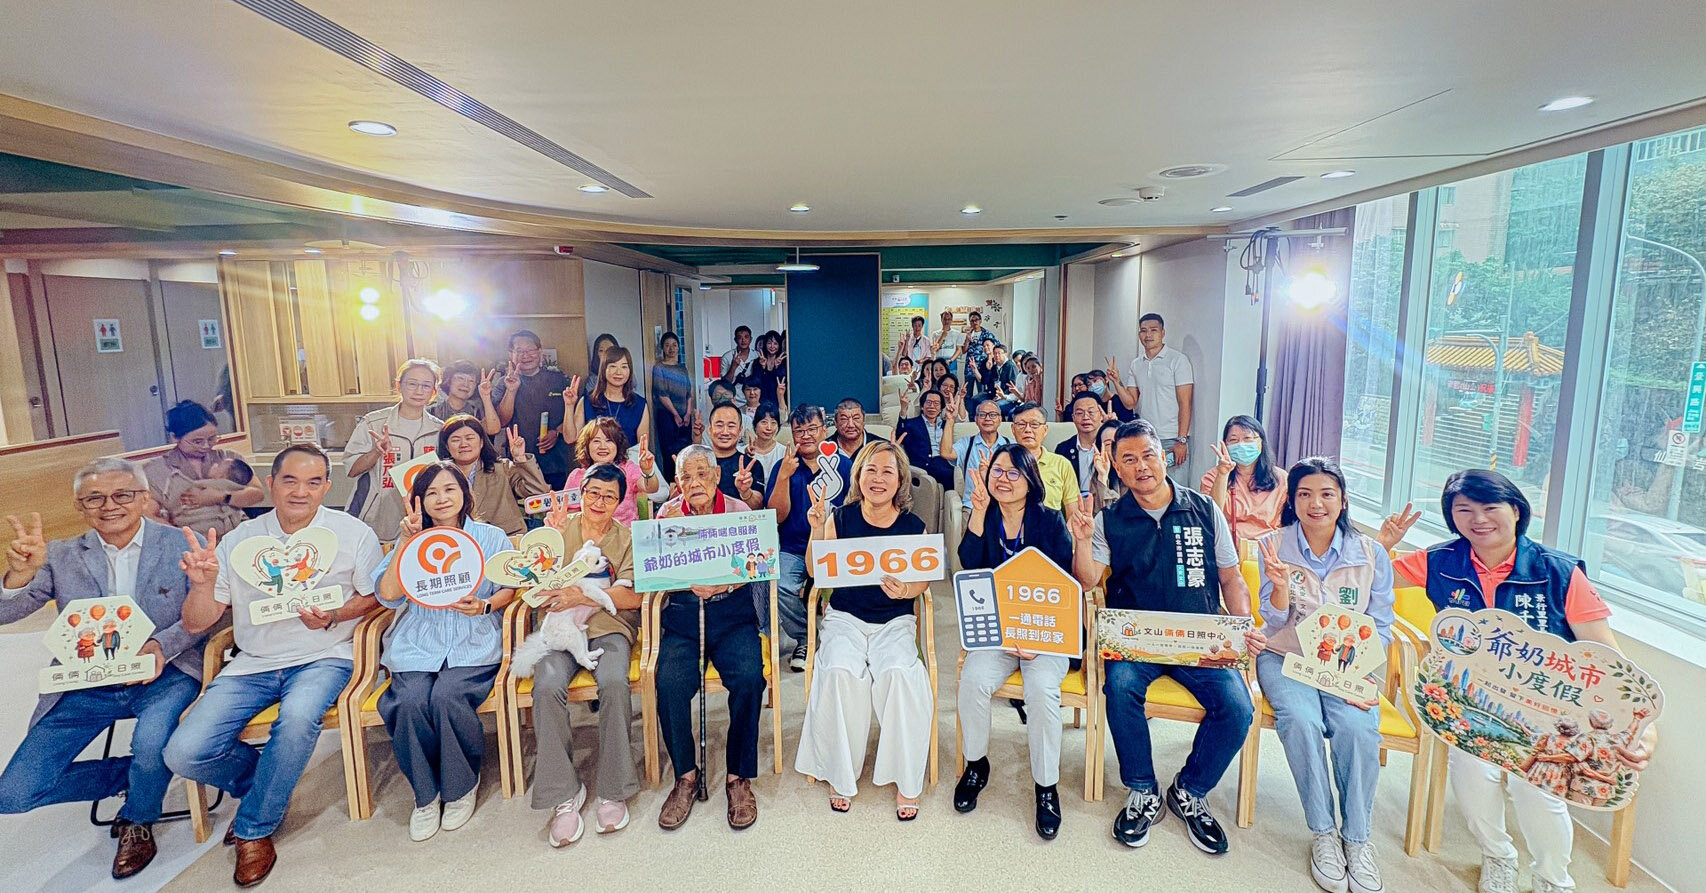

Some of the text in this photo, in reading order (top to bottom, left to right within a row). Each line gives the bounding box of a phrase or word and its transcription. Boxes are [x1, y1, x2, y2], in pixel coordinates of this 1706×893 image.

[699, 525, 758, 539] 倆倆喘息服務
[643, 537, 760, 573] 爺奶的城市小度假
[816, 547, 940, 578] 1966
[1183, 526, 1205, 588] 張志豪
[416, 571, 472, 593] 長期照顧
[1006, 584, 1061, 604] 1966
[1339, 586, 1359, 606] 劉
[1008, 612, 1057, 628] 一通電話
[1005, 626, 1065, 644] 長照到您家
[1143, 627, 1227, 641] 文山倆倆日照中心
[1484, 626, 1608, 691] 爺奶城市
[1499, 662, 1584, 708] 小度假
